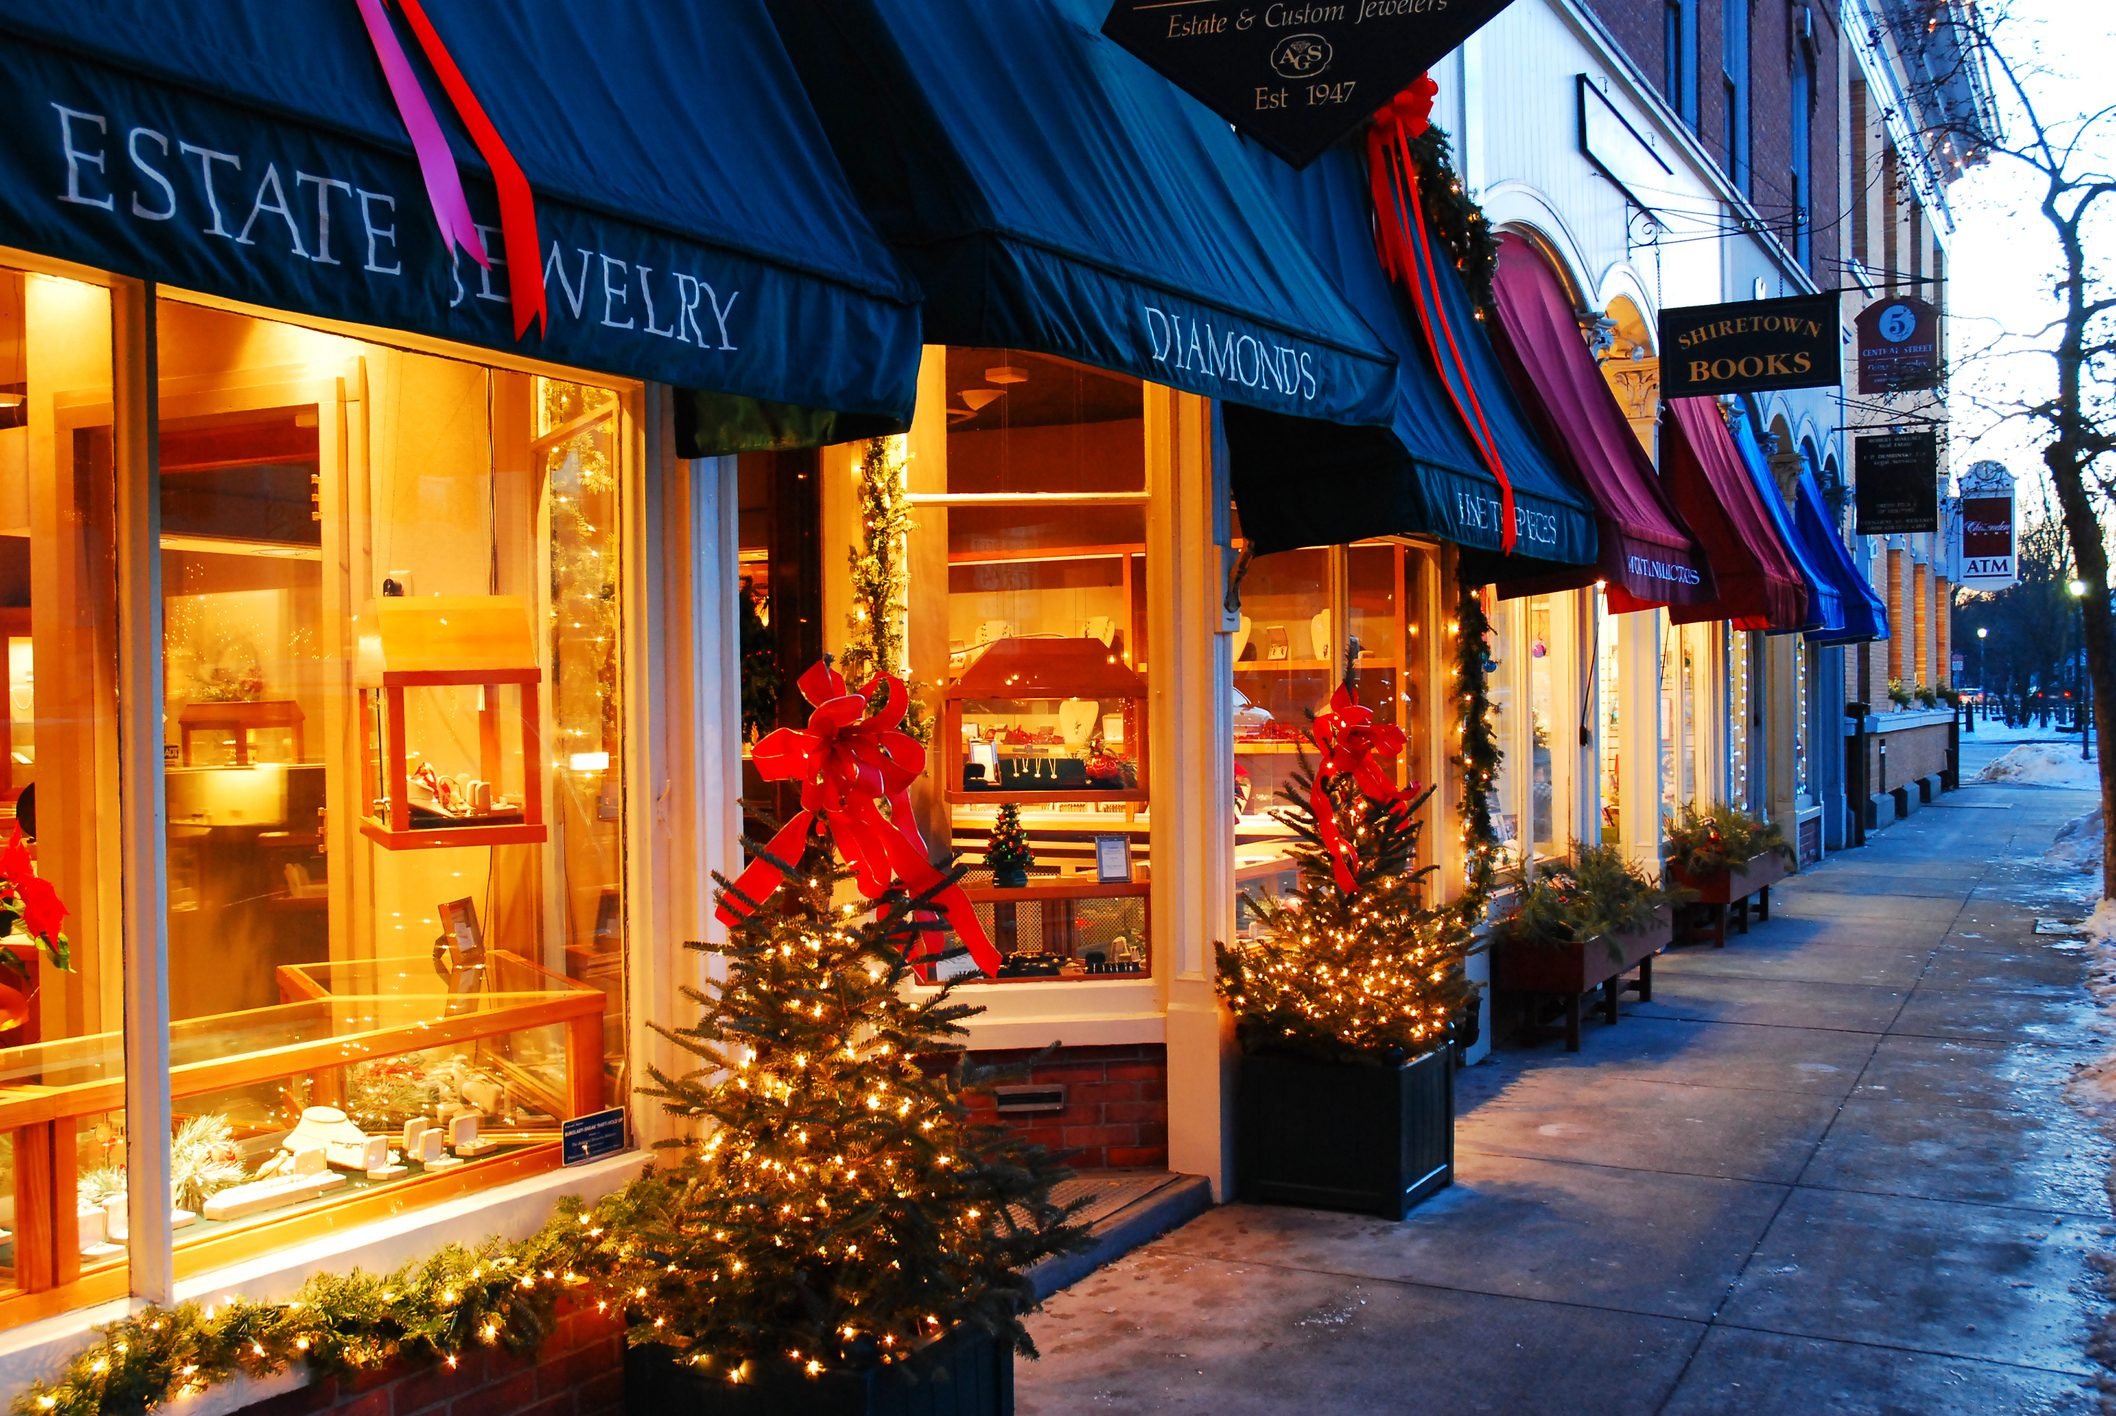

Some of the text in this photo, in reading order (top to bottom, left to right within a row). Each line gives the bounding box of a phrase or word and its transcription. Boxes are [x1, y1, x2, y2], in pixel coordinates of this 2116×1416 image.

[1167, 0, 1448, 38] Estate & Custom Jewelers
[1279, 44, 1323, 71] AGS
[1254, 81, 1356, 110] Est 1947
[51, 102, 401, 276] ESTATE
[1677, 315, 1822, 351] SHIRETOWN
[1888, 313, 1906, 335] 5
[1144, 306, 1316, 400] DIAMONDS
[1904, 344, 1933, 354] STREET
[1688, 351, 1812, 382] BOOKS
[1967, 559, 2008, 573] ATM
